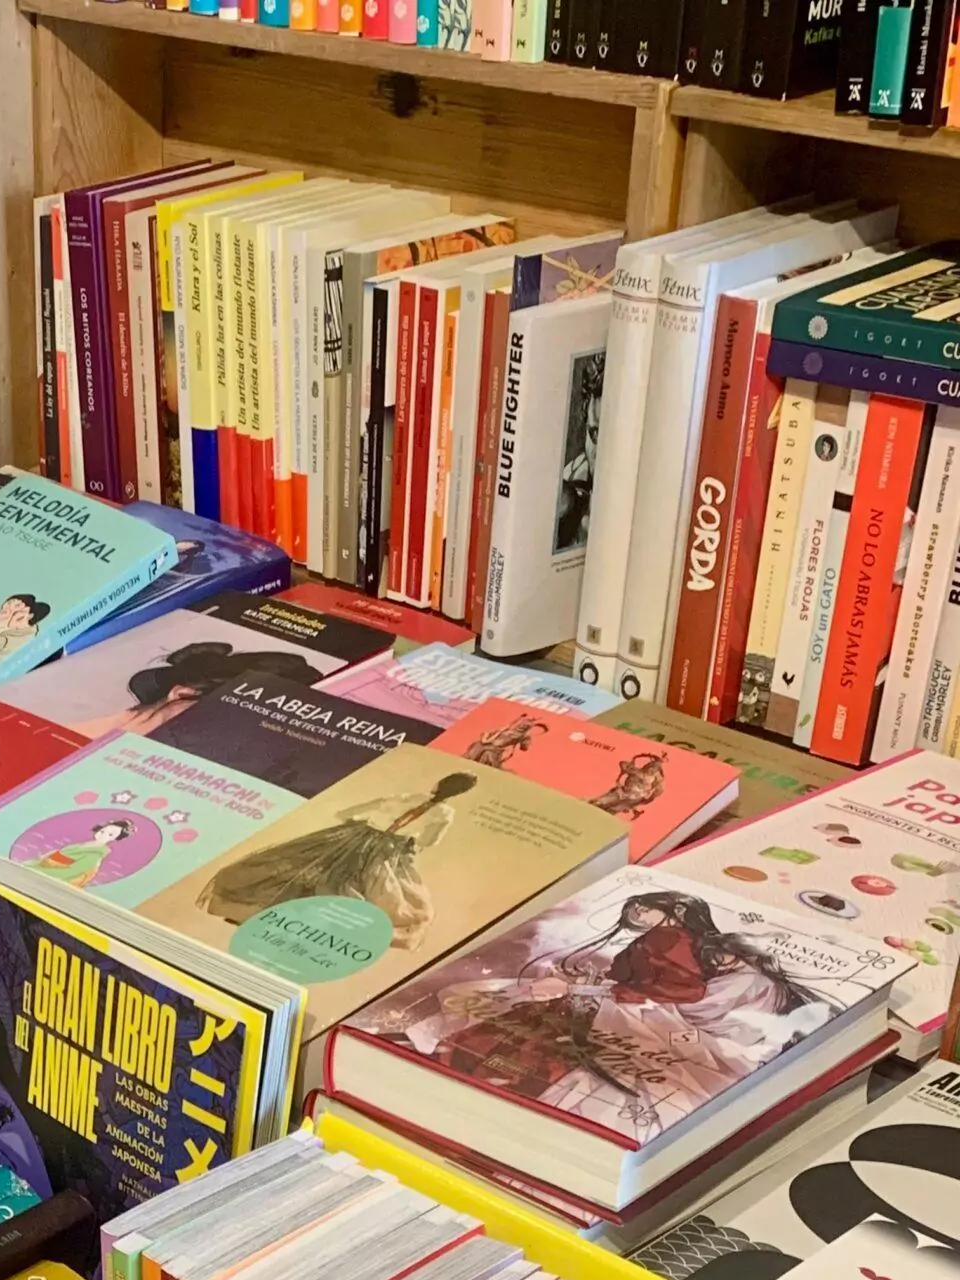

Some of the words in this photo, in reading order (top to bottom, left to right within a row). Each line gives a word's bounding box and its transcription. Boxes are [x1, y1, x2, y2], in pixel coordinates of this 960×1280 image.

[246, 240, 256, 293] flotante
[614, 267, 653, 293] Fénix
[79, 288, 88, 309] LOS
[661, 276, 702, 302] Fénix
[81, 312, 91, 349] MITOS
[247, 296, 257, 340] mundo
[248, 344, 258, 364] del
[854, 330, 924, 349] IGORT
[84, 352, 95, 412] COREANOS
[249, 368, 259, 410] artista
[504, 332, 524, 434] FIGHTER
[849, 366, 917, 387] IGORT
[499, 439, 515, 498] BLUE
[6, 485, 92, 527] MELODÍA
[868, 508, 885, 540] NO
[687, 476, 727, 592] GORDA
[806, 520, 824, 575] FLORES
[863, 541, 878, 567] LO
[108, 575, 141, 601] MELODÍA
[799, 576, 814, 621] ROJAS
[820, 568, 837, 610] GATO
[851, 569, 872, 629] ABRAS
[57, 594, 110, 637] SENTIMENTAL
[817, 611, 828, 633] un
[811, 635, 825, 664] SOY
[841, 630, 861, 689] JAMÁS
[232, 682, 268, 701] LA
[265, 692, 336, 725] ABEJA
[335, 714, 409, 746] REINA
[259, 910, 374, 965] PACHINKO
[22, 981, 33, 1014] EL
[34, 936, 101, 1052] GRAN
[101, 974, 178, 1095] LIBRO
[15, 1015, 30, 1052] DEL
[27, 1026, 104, 1145] ANIME
[114, 1092, 168, 1130] MAESTRAS
[111, 1147, 163, 1185] JAPONESA
